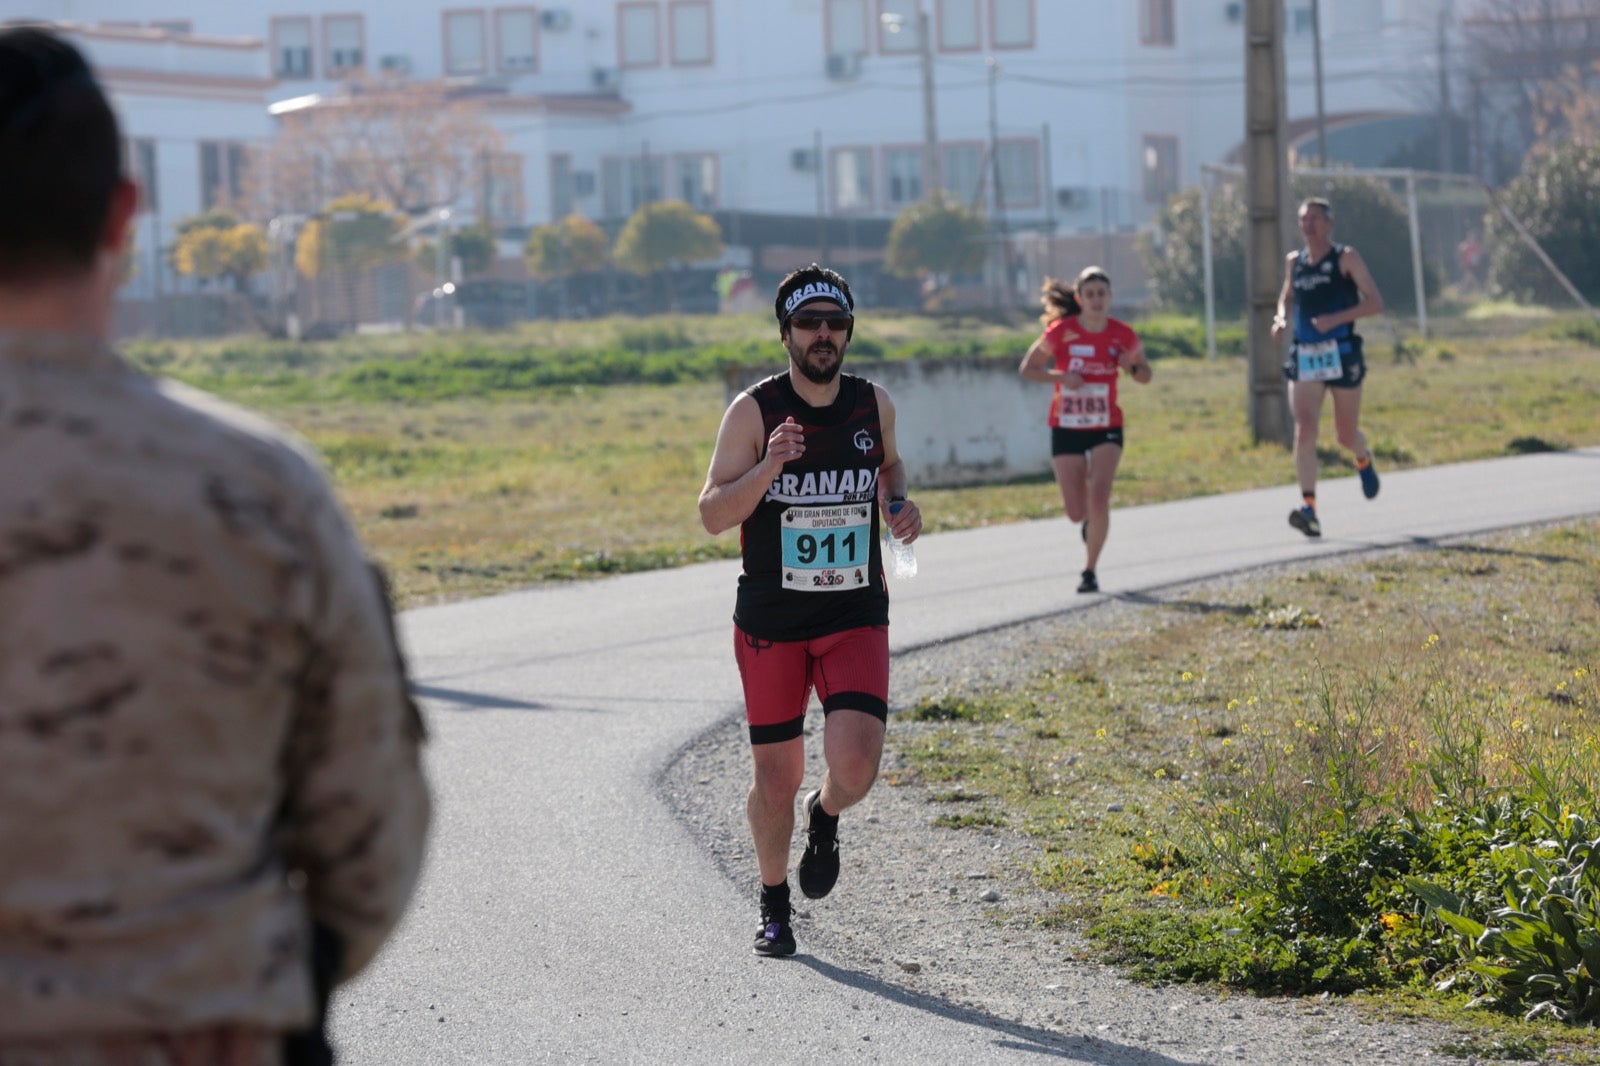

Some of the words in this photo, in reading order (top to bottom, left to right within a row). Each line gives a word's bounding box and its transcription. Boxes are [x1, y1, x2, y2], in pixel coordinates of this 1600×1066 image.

[1063, 396, 1106, 415] 2183
[804, 509, 820, 518] GRAN
[821, 508, 842, 518] PREMIO
[843, 507, 850, 516] DE
[812, 518, 846, 528] DIPUTACIÓN
[796, 531, 856, 564] 911
